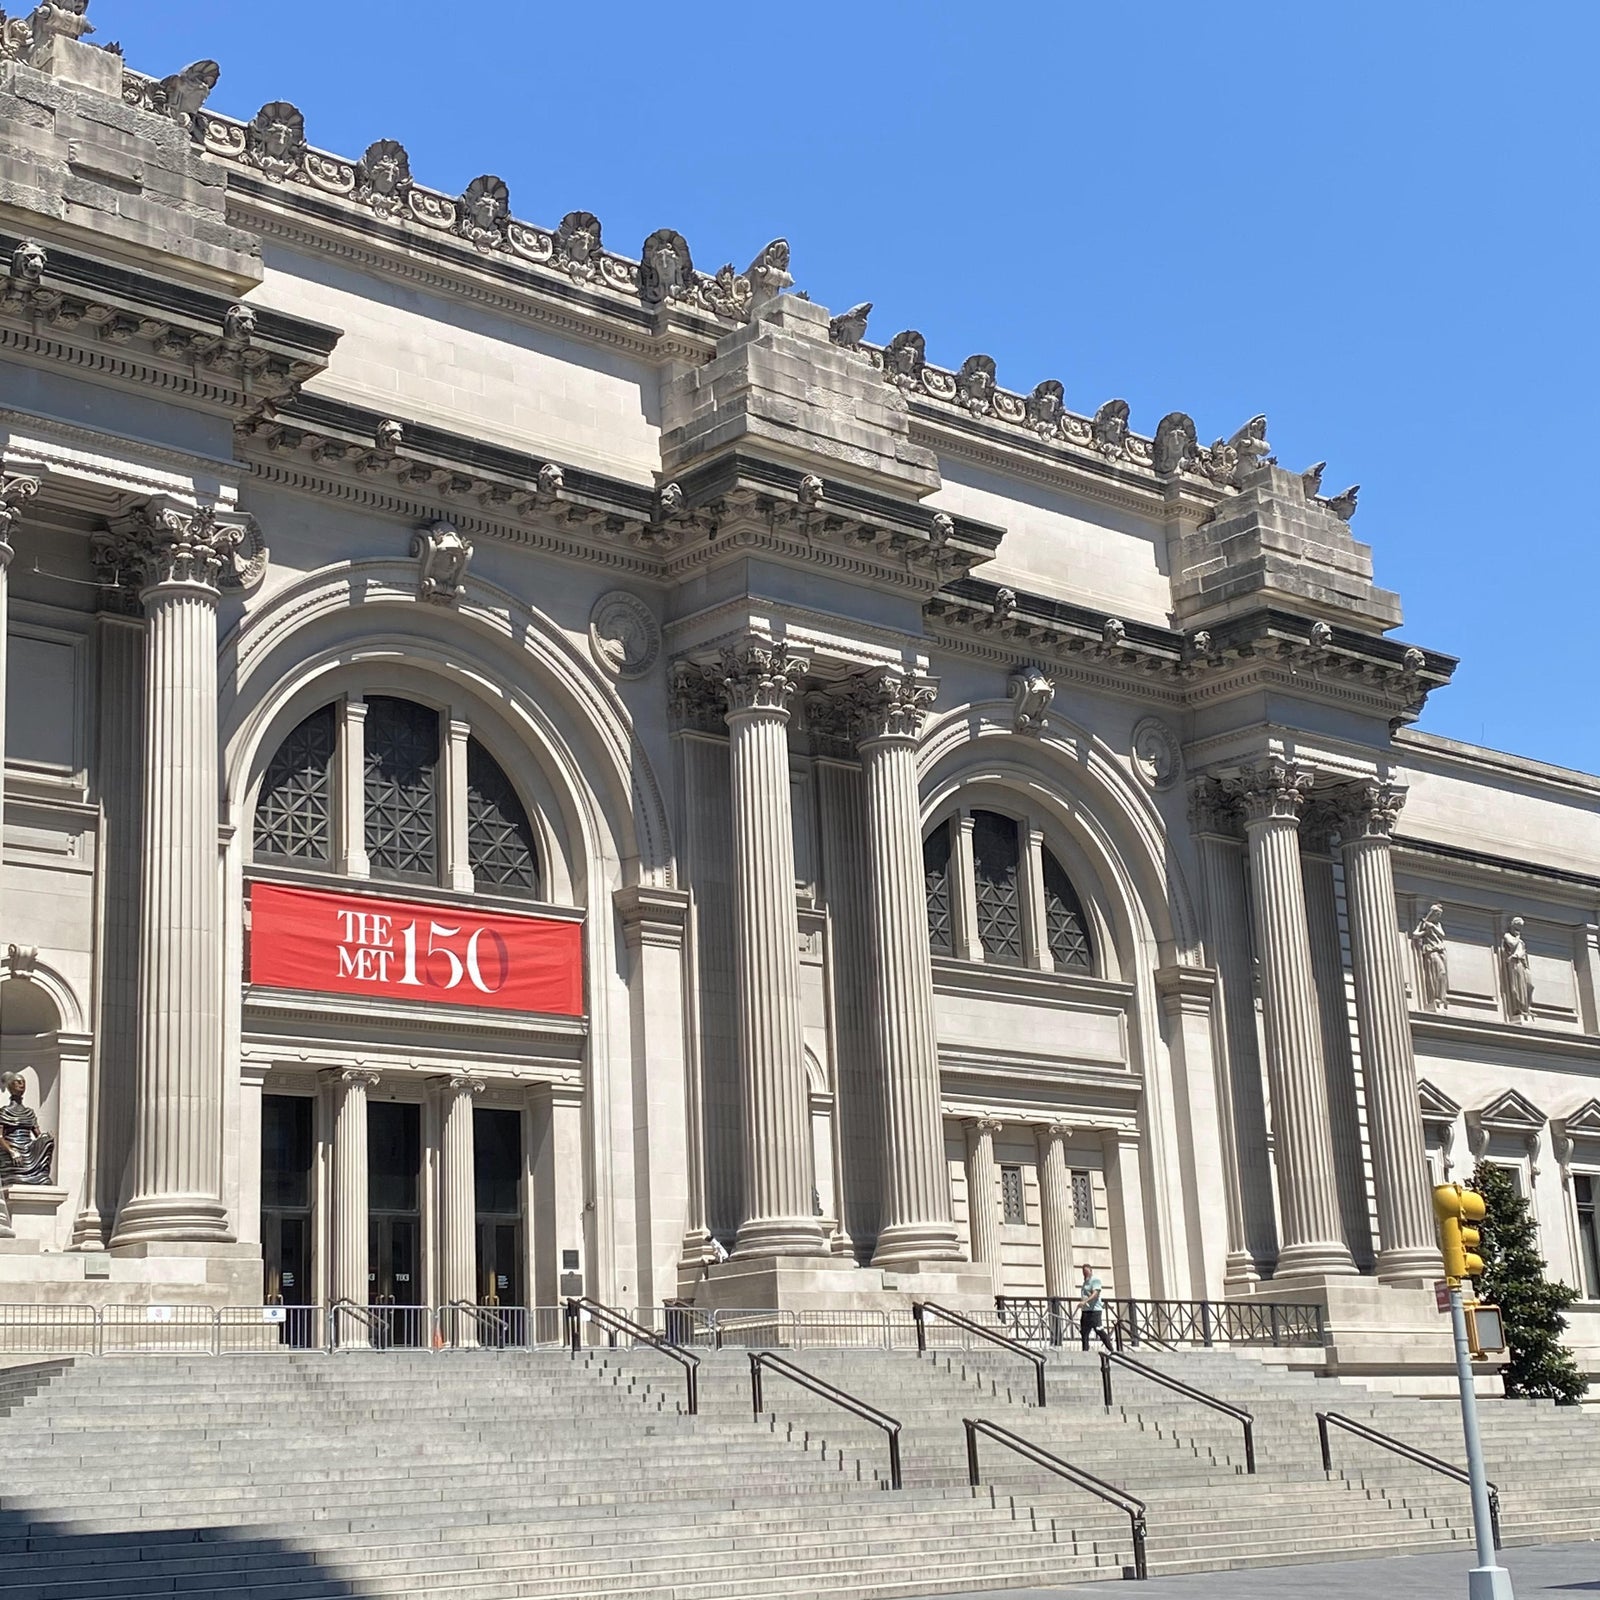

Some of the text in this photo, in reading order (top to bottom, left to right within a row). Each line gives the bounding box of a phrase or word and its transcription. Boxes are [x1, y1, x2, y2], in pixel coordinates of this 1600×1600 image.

[337, 910, 393, 947] THE
[336, 945, 394, 982] MET
[397, 919, 508, 993] 150
